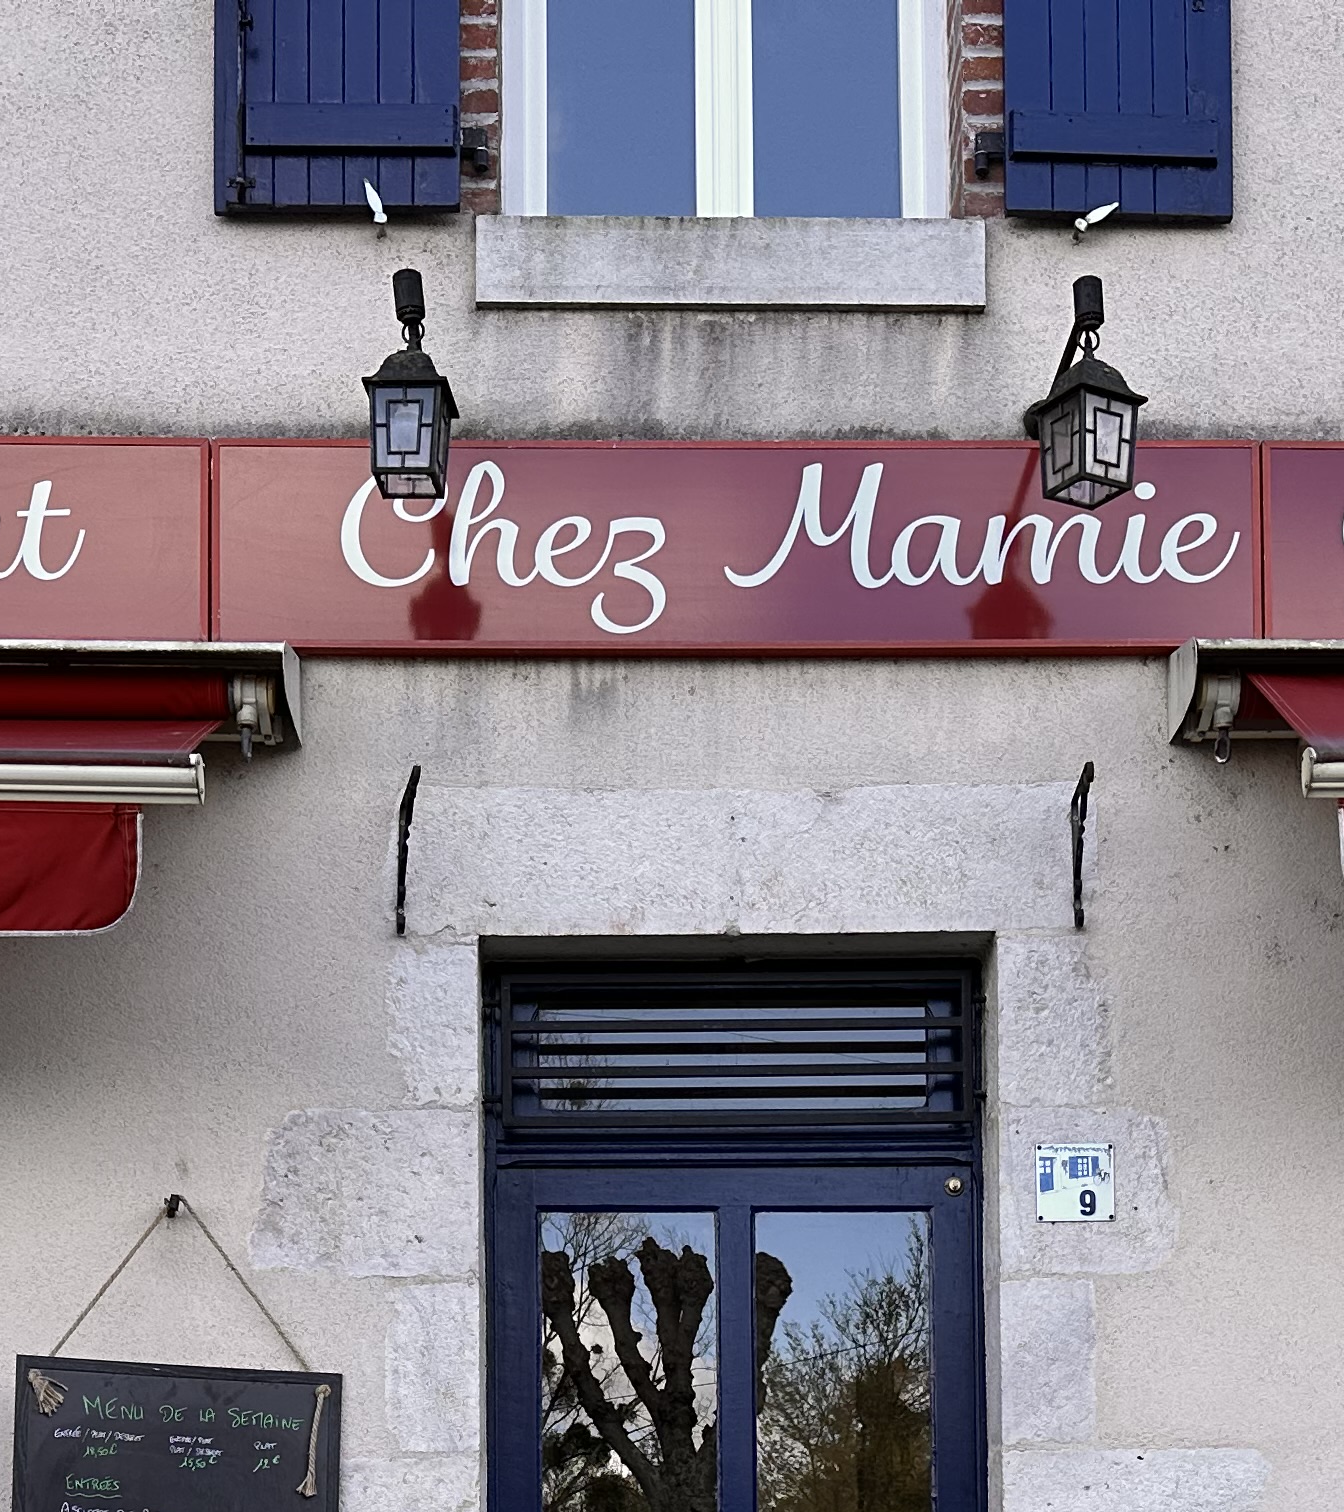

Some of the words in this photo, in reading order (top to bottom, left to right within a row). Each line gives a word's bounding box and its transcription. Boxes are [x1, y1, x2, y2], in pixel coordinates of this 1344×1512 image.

[340, 461, 666, 634] Chez
[724, 462, 1242, 589] Mamie
[1079, 1190, 1097, 1216] 9
[83, 1395, 144, 1420] MENU
[159, 1405, 188, 1422] DE
[200, 1408, 215, 1422] LA
[228, 1407, 304, 1431] SEMAINE
